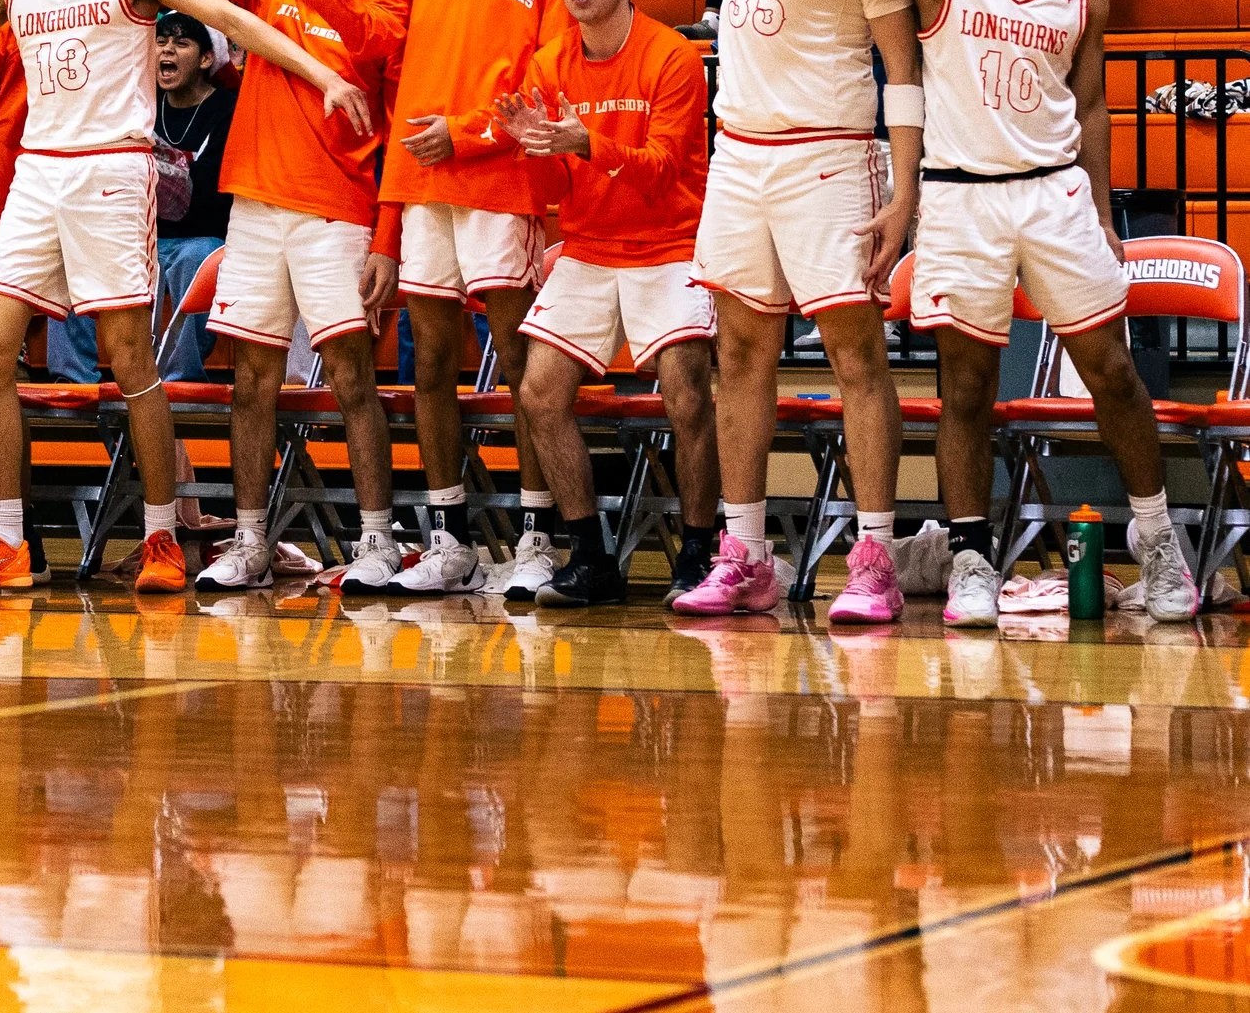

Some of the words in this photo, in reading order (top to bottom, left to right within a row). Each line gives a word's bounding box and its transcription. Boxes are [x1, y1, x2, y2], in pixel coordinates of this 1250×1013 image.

[16, 1, 111, 38] LONGHORNS
[960, 9, 1069, 56] LONGHORNS
[35, 38, 91, 96] 13
[979, 49, 1043, 114] 10
